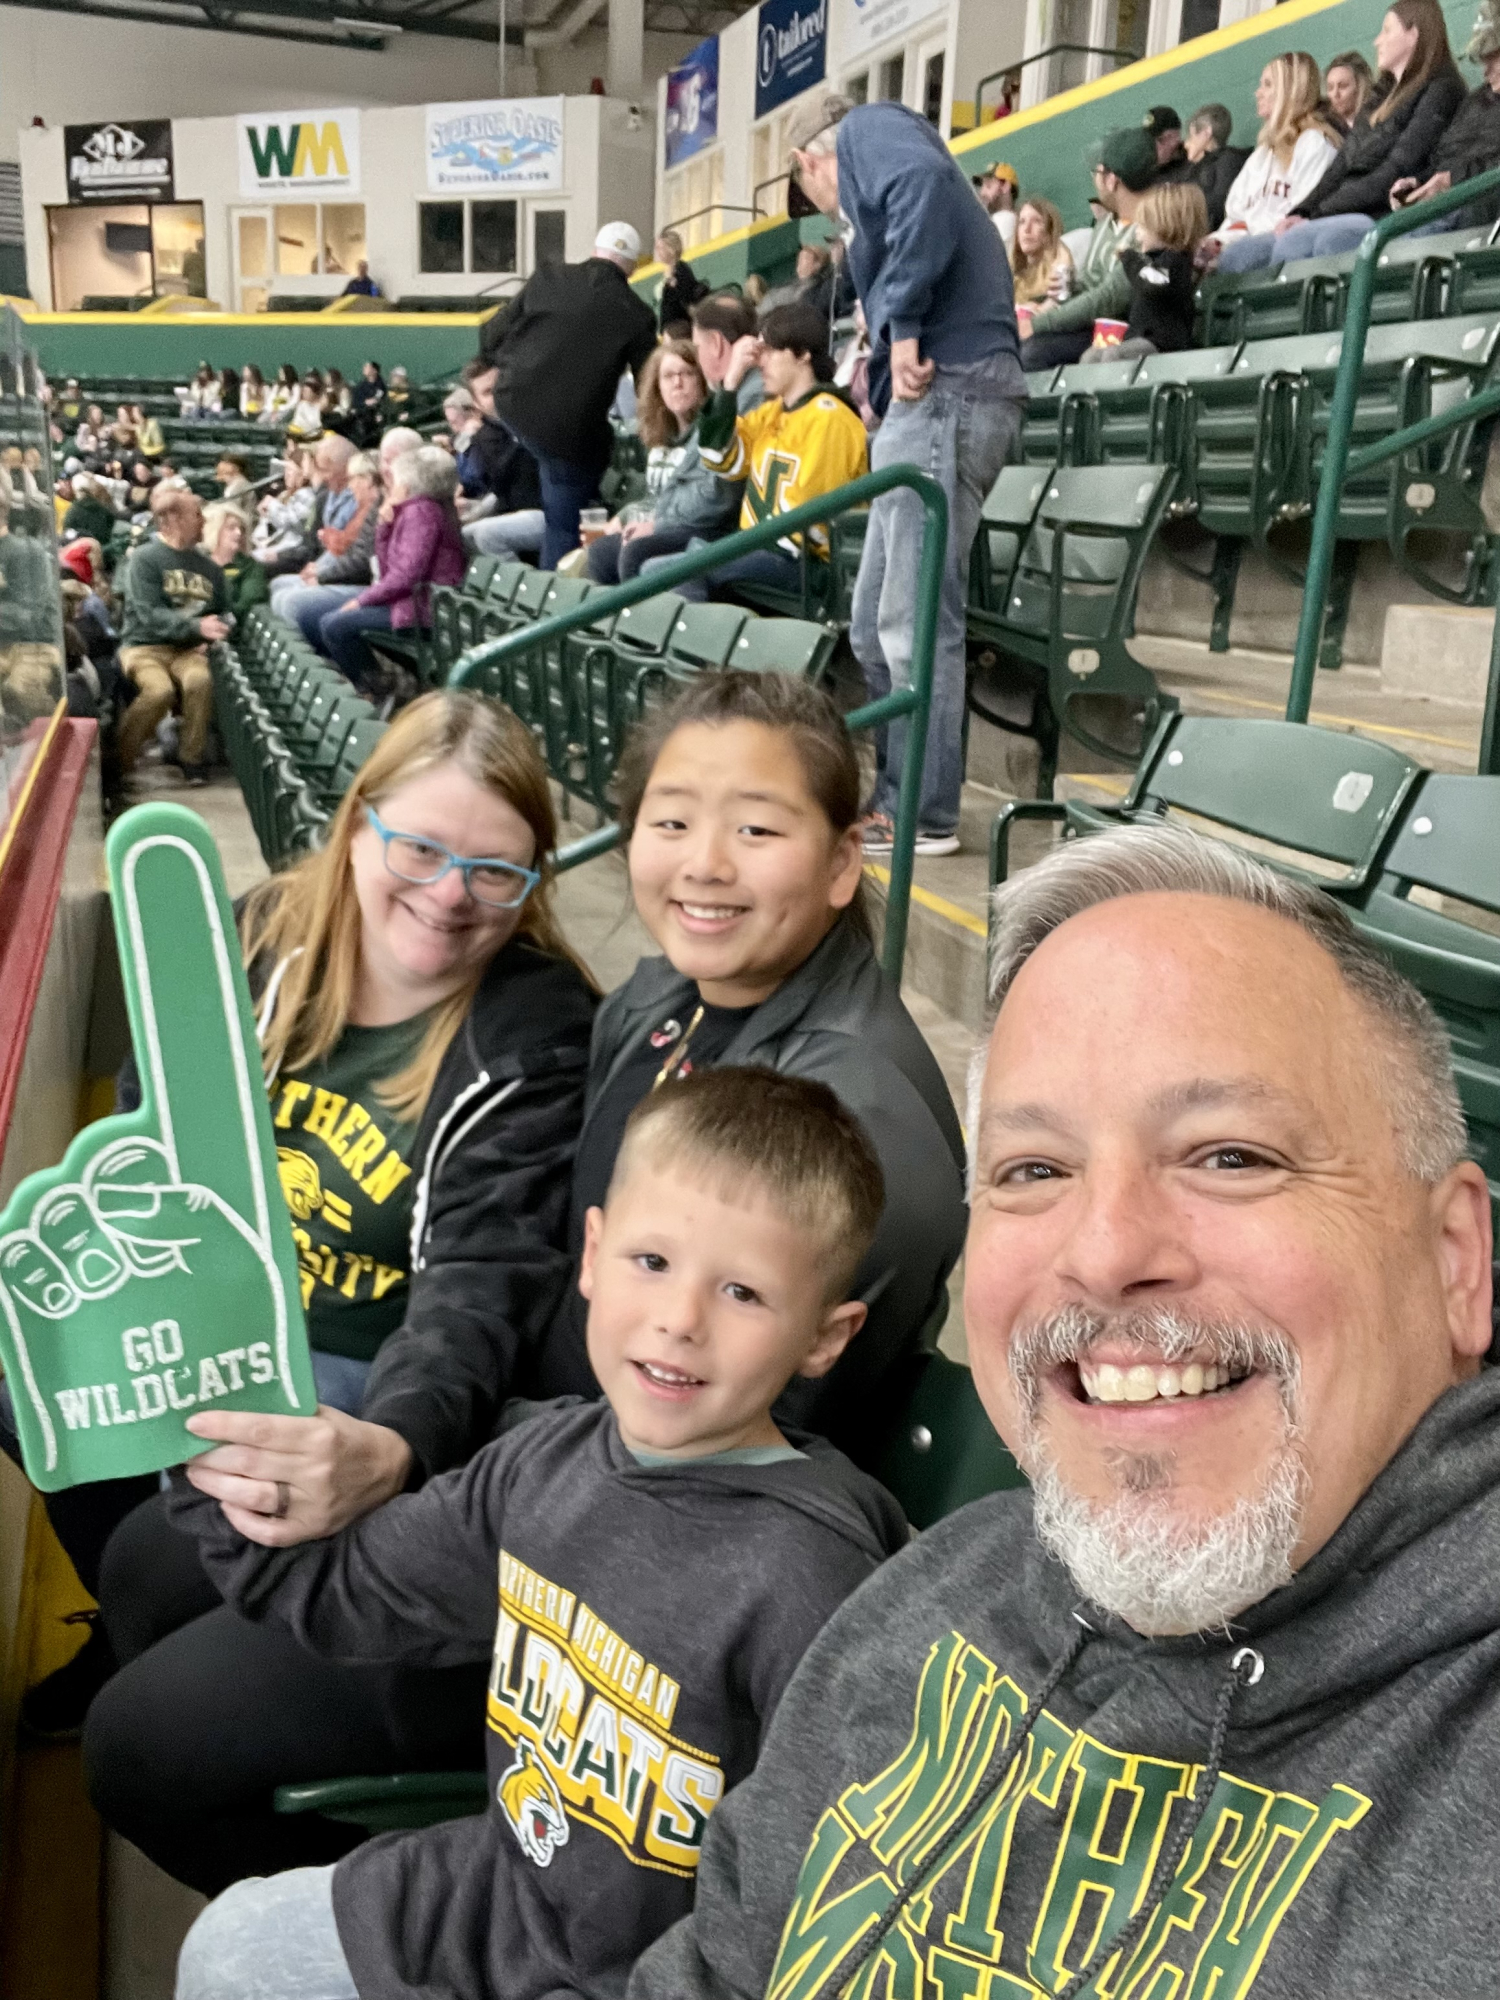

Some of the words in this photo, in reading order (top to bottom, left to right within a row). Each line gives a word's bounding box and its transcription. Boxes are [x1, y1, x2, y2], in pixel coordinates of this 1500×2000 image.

[246, 120, 350, 178] WM
[268, 1078, 413, 1205] THERN
[54, 1341, 275, 1431] WILDCATS
[121, 1318, 184, 1372] GO
[570, 1602, 682, 1731] MICHIGAN
